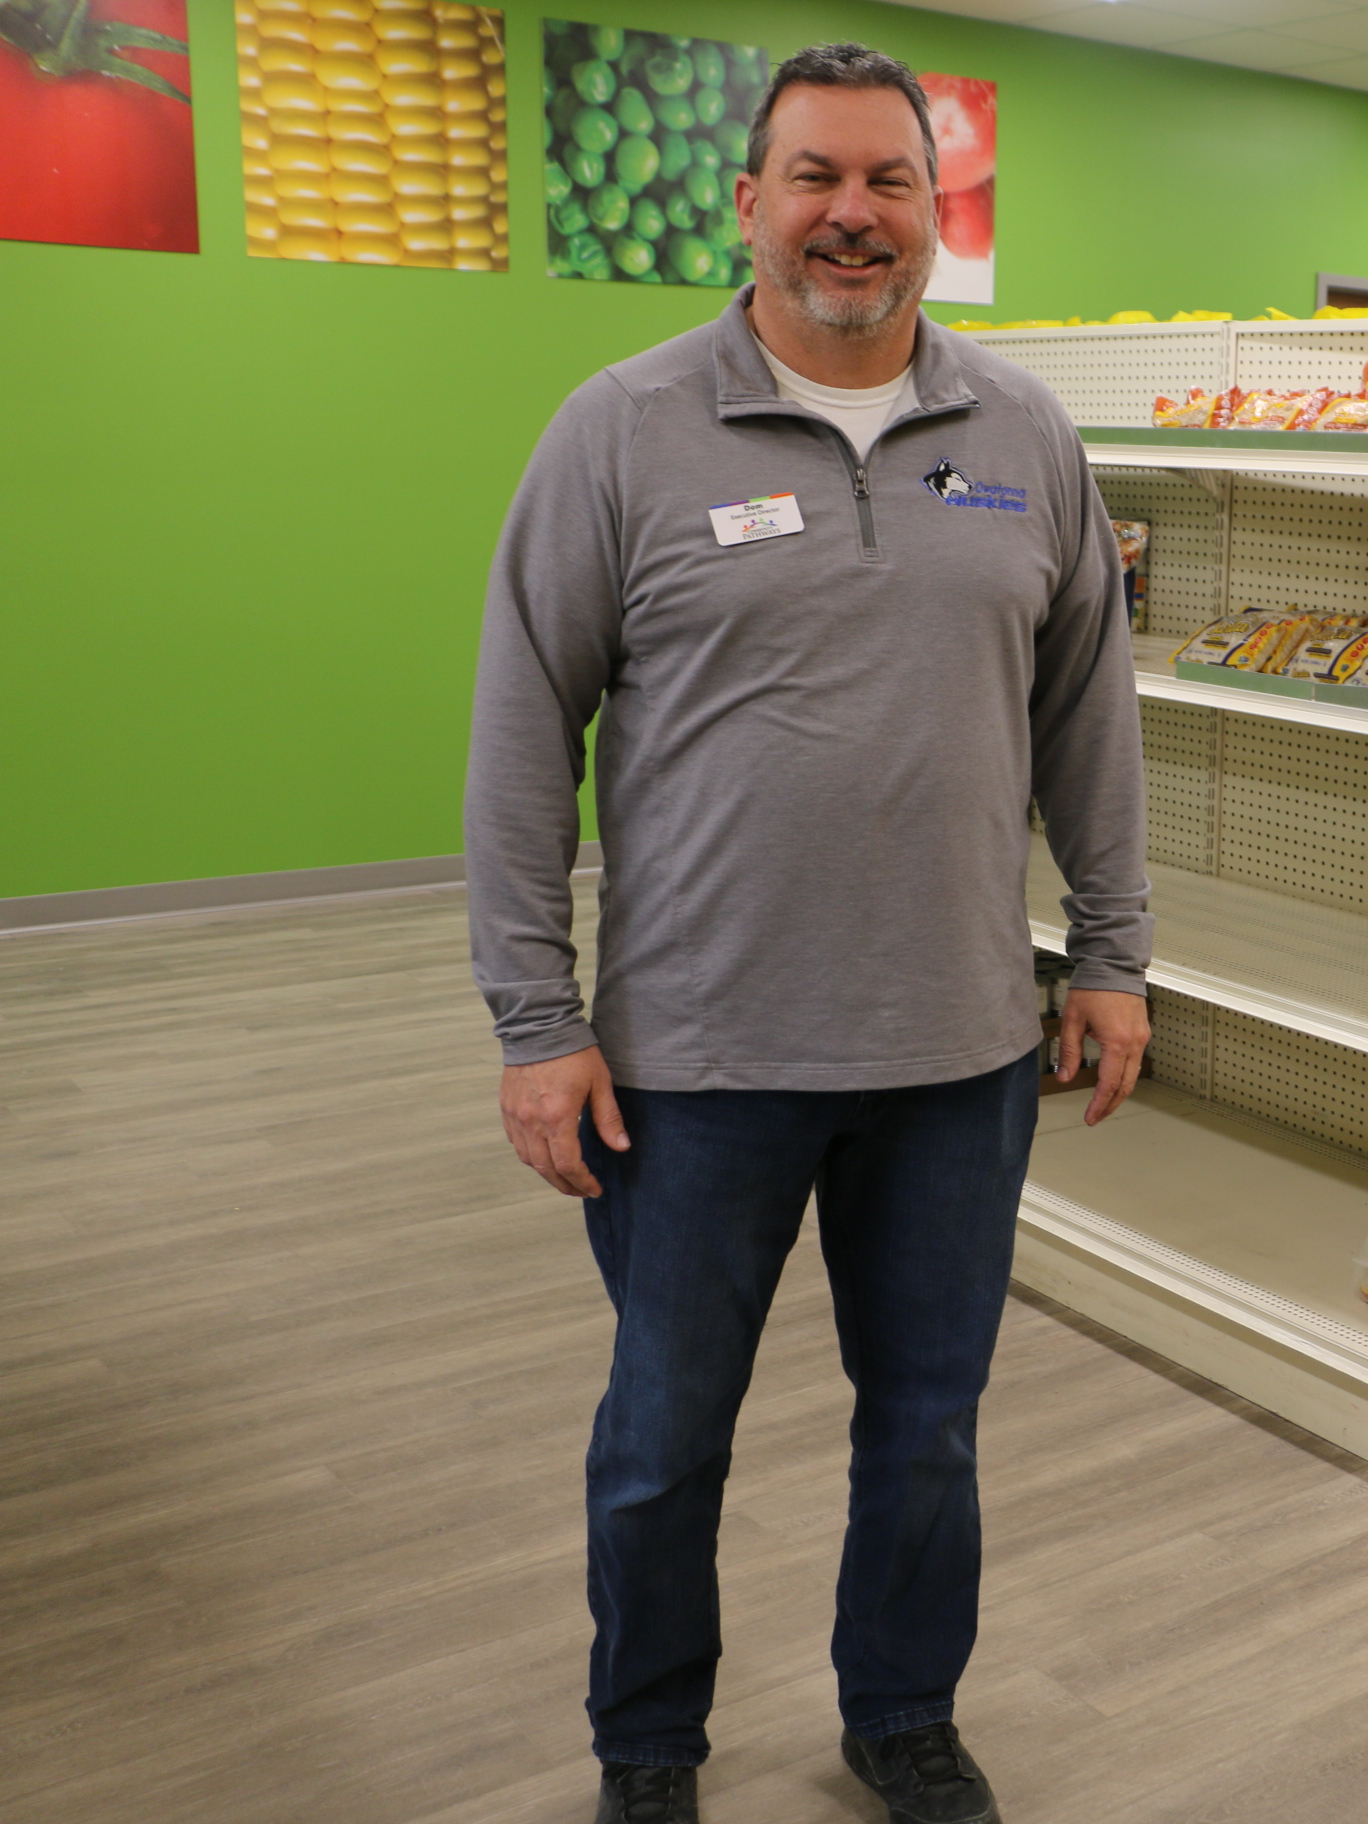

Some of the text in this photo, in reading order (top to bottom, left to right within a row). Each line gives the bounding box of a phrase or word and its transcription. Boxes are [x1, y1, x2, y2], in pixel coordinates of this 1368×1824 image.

[730, 507, 780, 520] Executive Director
[742, 528, 781, 540] PATHWAYS
